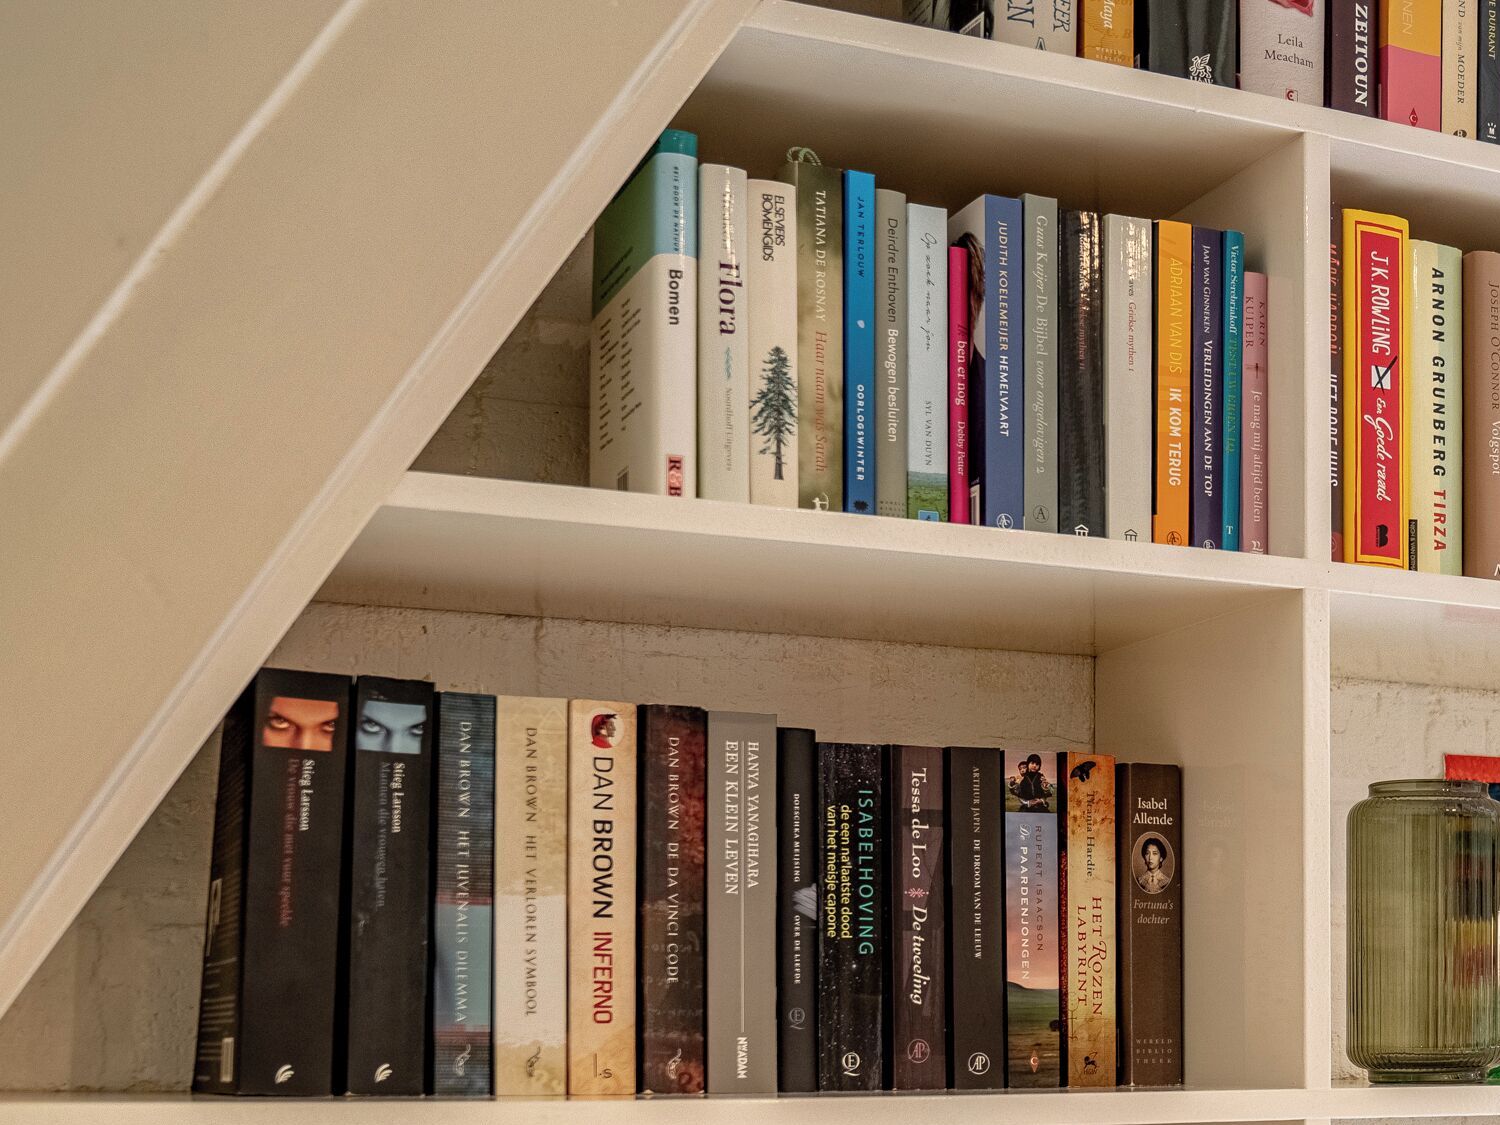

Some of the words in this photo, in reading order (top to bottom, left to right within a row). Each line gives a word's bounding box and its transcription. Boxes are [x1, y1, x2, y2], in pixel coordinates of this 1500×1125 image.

[1278, 34, 1304, 48] Leila
[1355, 3, 1368, 107] ZEITOUN
[1488, 10, 1496, 60] DURRANT
[1264, 50, 1314, 69] Meacham
[762, 193, 774, 262] BOMENGIDS
[774, 195, 785, 247] ELSEVIERS
[815, 190, 827, 246] TATIANA
[888, 218, 900, 264] Deirdre
[815, 250, 826, 267] DE
[857, 225, 865, 278] TERLOUW
[998, 221, 1008, 265] JUDITH
[1371, 251, 1389, 281] J.K.
[669, 269, 683, 326] Bomen
[719, 260, 743, 336] Flora
[815, 271, 827, 321] ROSNAY
[888, 267, 900, 323] Enthoven
[999, 270, 1009, 351] KOELEMEIJER
[1169, 257, 1183, 318] ADRIAAN
[1203, 287, 1212, 333] GINNEKEN
[1432, 268, 1445, 342] ARNON
[1489, 280, 1500, 331] JOSEPH
[885, 329, 898, 384] Bewogen
[1033, 318, 1048, 357] Bijbel
[1169, 321, 1183, 348] VAN
[1169, 352, 1183, 375] DIS
[1203, 340, 1212, 425] VERLEIDINGEN
[888, 386, 901, 442] besluiten
[999, 356, 1009, 436] HEMELVAART
[1169, 388, 1181, 402] IK
[1432, 356, 1446, 477] GRUNBERG
[857, 384, 865, 481] OORLOGSWINTER
[1169, 406, 1181, 437] KOM
[1364, 415, 1393, 461] Goede
[815, 435, 828, 472] Sarah
[1169, 443, 1181, 486] TERUG
[1489, 420, 1500, 475] Volgspot
[1376, 463, 1391, 502] raad
[1433, 490, 1447, 551] TIRZA
[460, 722, 471, 753] DAN
[526, 727, 537, 759] DAN
[668, 737, 680, 768] DAN
[725, 741, 739, 775] EEN
[299, 759, 315, 786] Stieg
[390, 763, 405, 788] Stieg
[457, 760, 471, 817] BROWN
[593, 757, 614, 810] DAN
[747, 741, 760, 790] HANYA
[299, 789, 313, 831] Larsson
[391, 792, 404, 833] Larsson
[526, 766, 537, 822] BROWN
[668, 774, 680, 830] BROWN
[725, 781, 739, 833] KLEIN
[911, 767, 927, 814] Tessa
[1138, 798, 1167, 810] Isabel
[827, 805, 836, 827] van
[911, 818, 929, 840] de
[1133, 813, 1173, 825] Allende
[526, 836, 537, 859] HET
[668, 843, 679, 860] DE
[747, 795, 760, 888] YANAGIHARA
[911, 843, 927, 879] Loo
[592, 820, 614, 918] BROWN
[667, 868, 679, 888] DA
[725, 838, 739, 895] LEVEN
[825, 852, 840, 887] meisje
[525, 869, 537, 943] VERLOREN
[667, 893, 679, 937] VINCI
[841, 907, 852, 939] dood
[912, 903, 928, 931] De
[1020, 847, 1030, 980] PAARDENJONGEN
[1036, 884, 1044, 951] ISAACSON
[1092, 897, 1102, 936] HET
[1134, 899, 1174, 910] Fortuna's
[1137, 914, 1170, 924] dochter
[592, 932, 613, 1025] INFERNO
[666, 943, 679, 984] CODE
[909, 935, 931, 1005] tweeling
[1077, 905, 1088, 1007] LABYRINT
[1087, 941, 1107, 1015] ROZEN
[455, 951, 468, 1022] DILEMMA
[524, 950, 537, 1017] SYMBOOL
